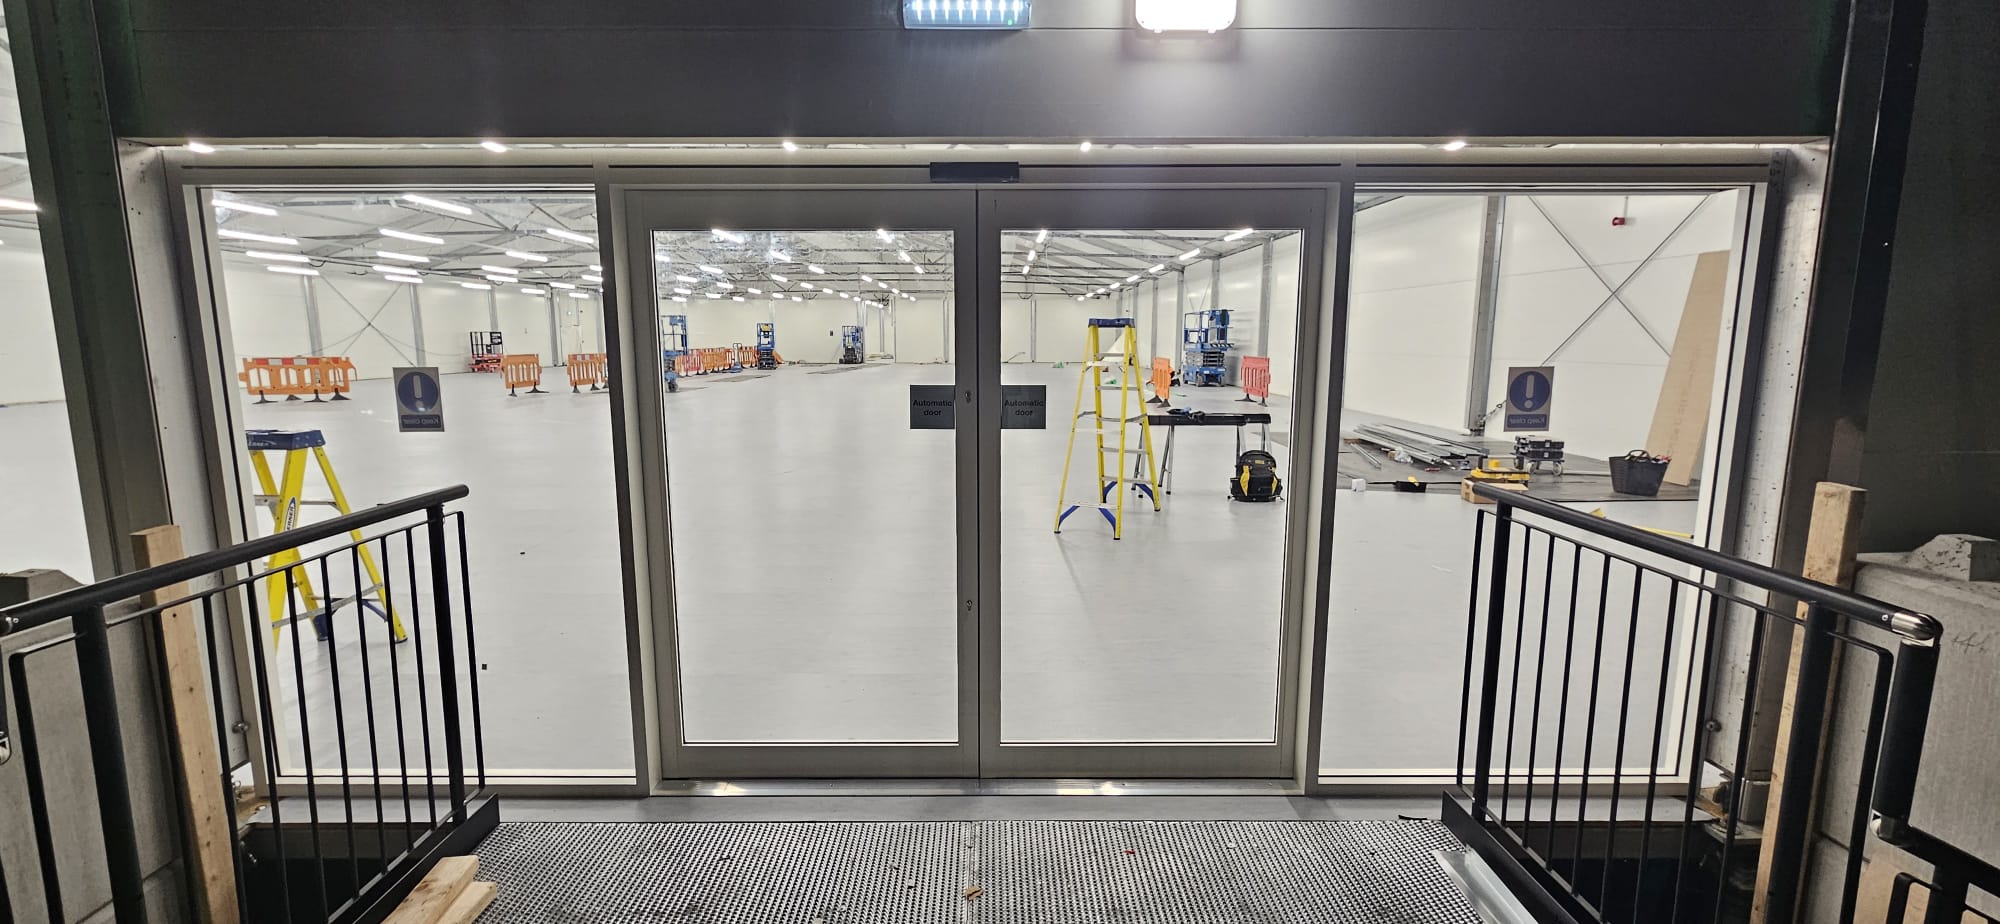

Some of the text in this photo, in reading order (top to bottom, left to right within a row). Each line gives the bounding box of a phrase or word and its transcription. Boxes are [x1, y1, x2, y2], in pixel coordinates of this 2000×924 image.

[912, 399, 953, 407] Automatic
[1004, 399, 1044, 407] Automatic
[923, 408, 942, 416] door
[1015, 408, 1033, 416] door
